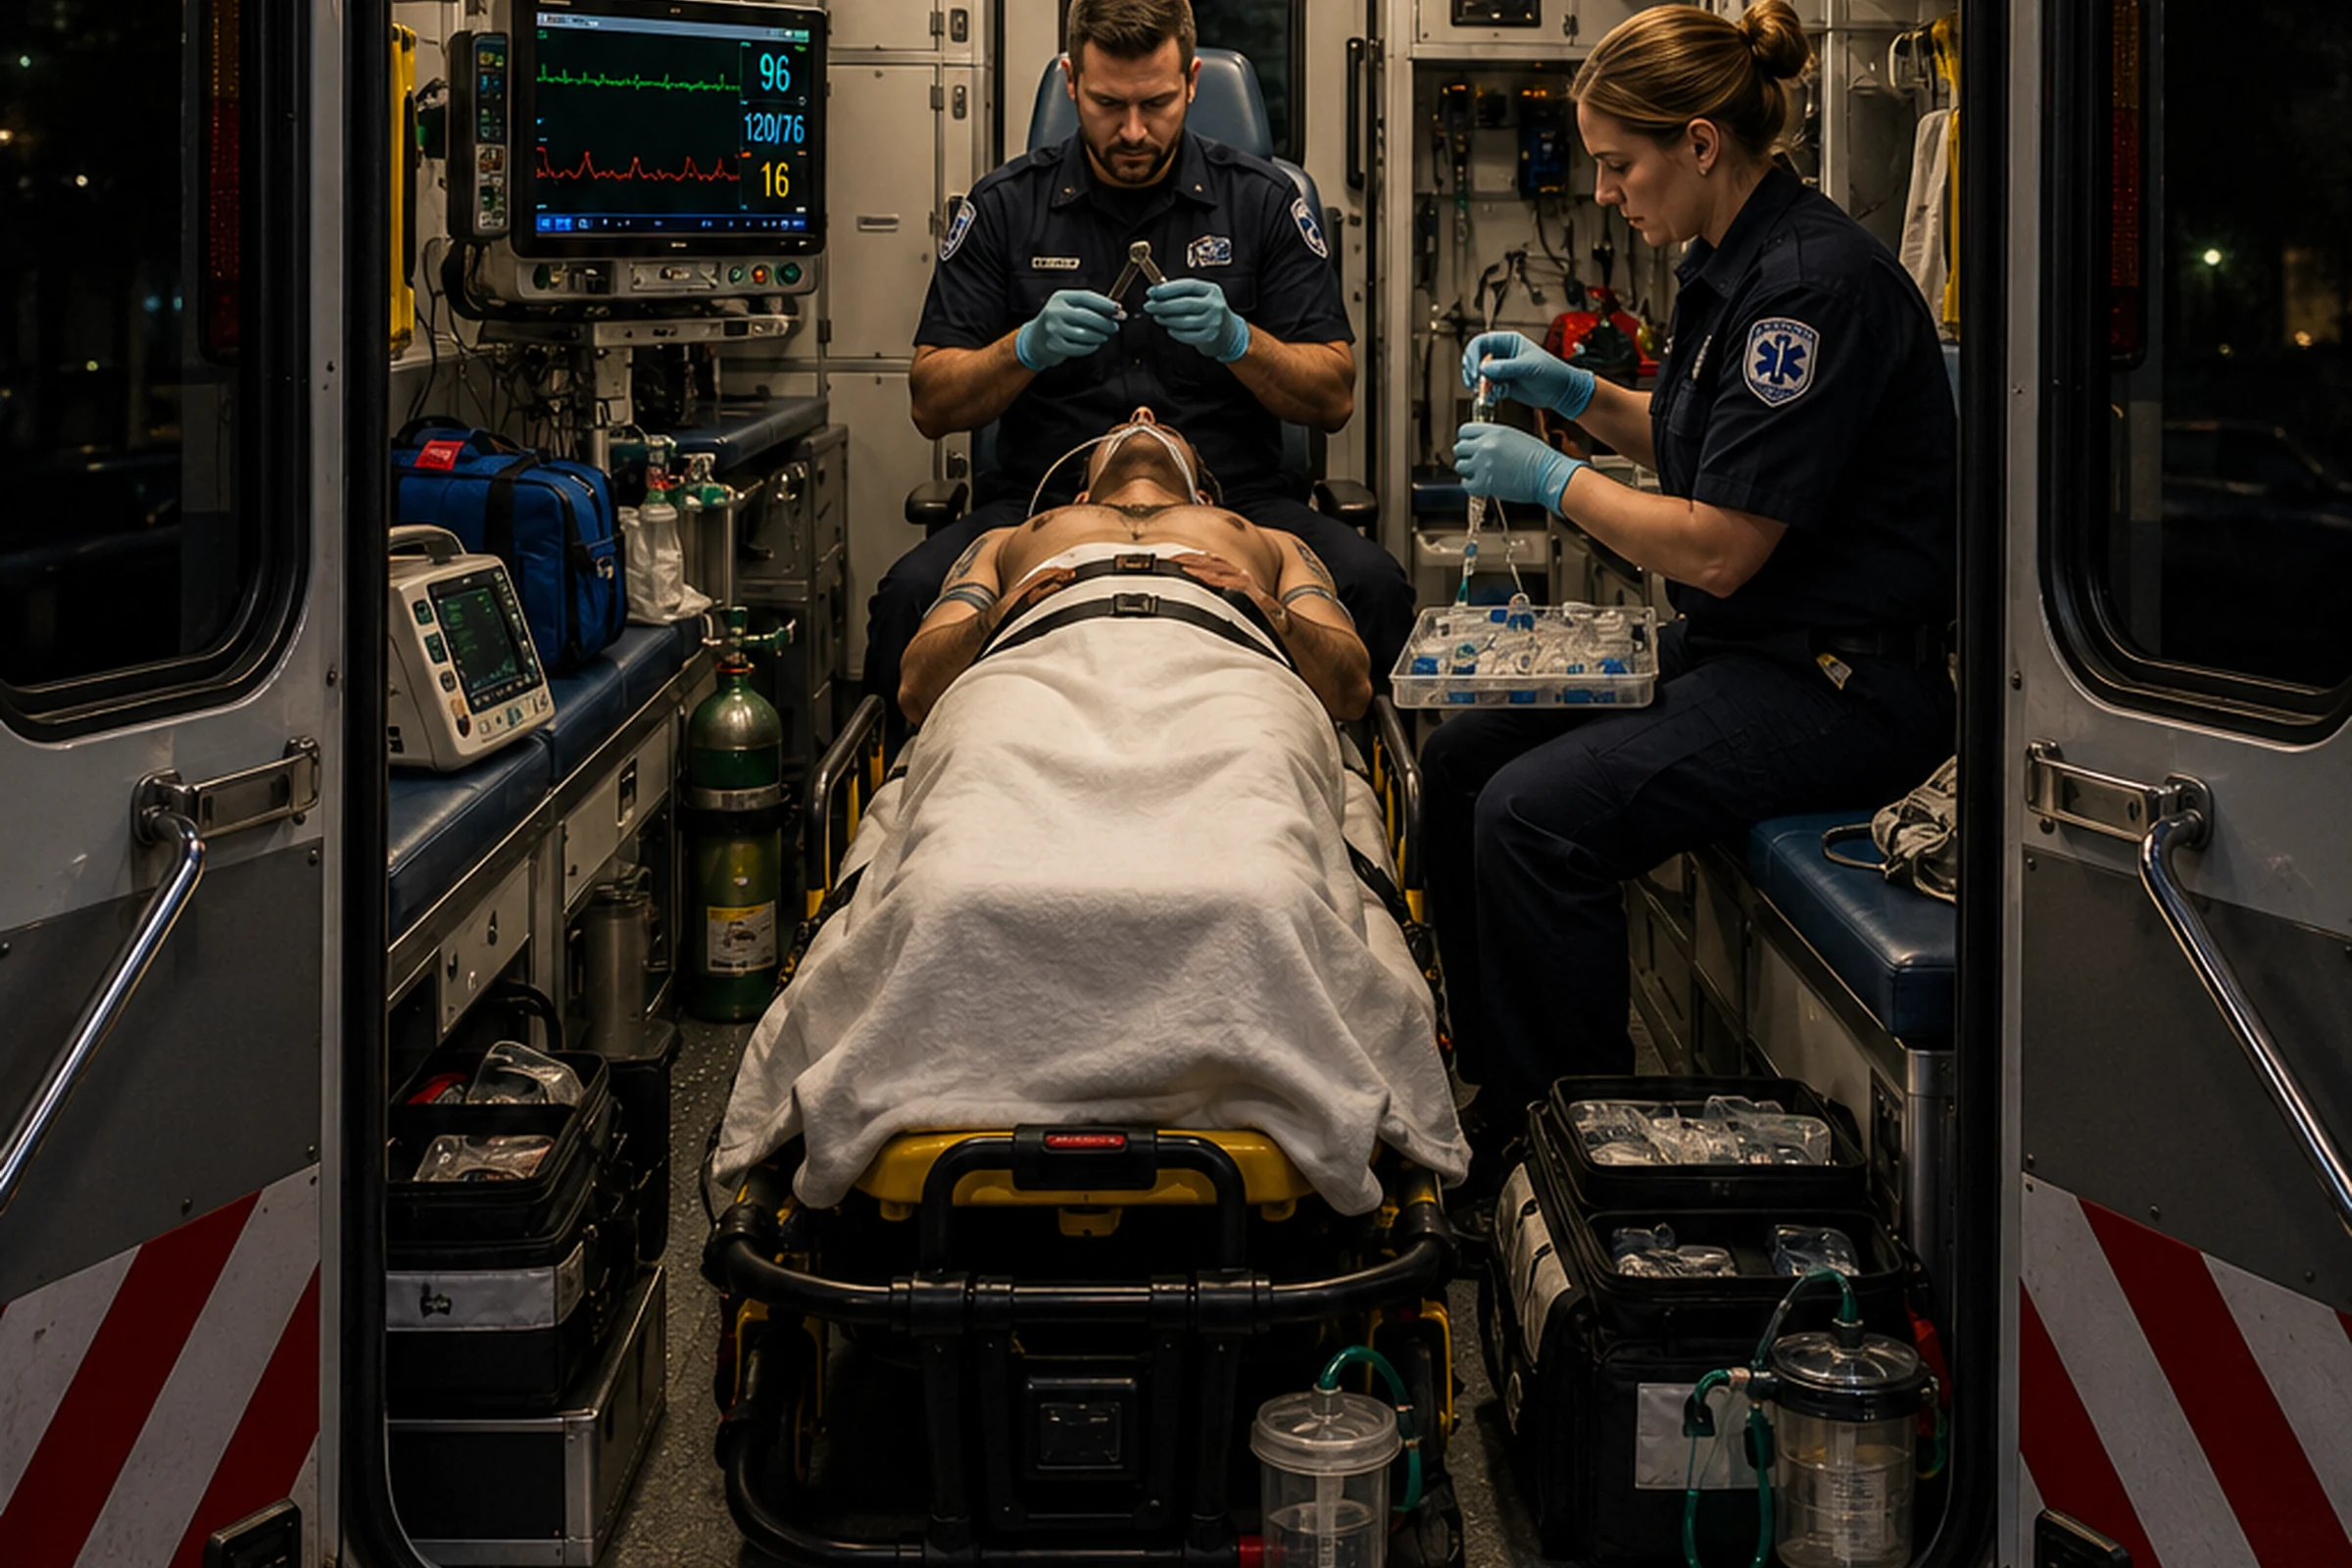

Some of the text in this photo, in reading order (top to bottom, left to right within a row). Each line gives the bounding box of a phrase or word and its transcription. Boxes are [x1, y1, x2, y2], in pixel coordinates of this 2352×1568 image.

[760, 53, 792, 92] 96
[743, 112, 806, 145] 120/76
[760, 161, 790, 198] 16
